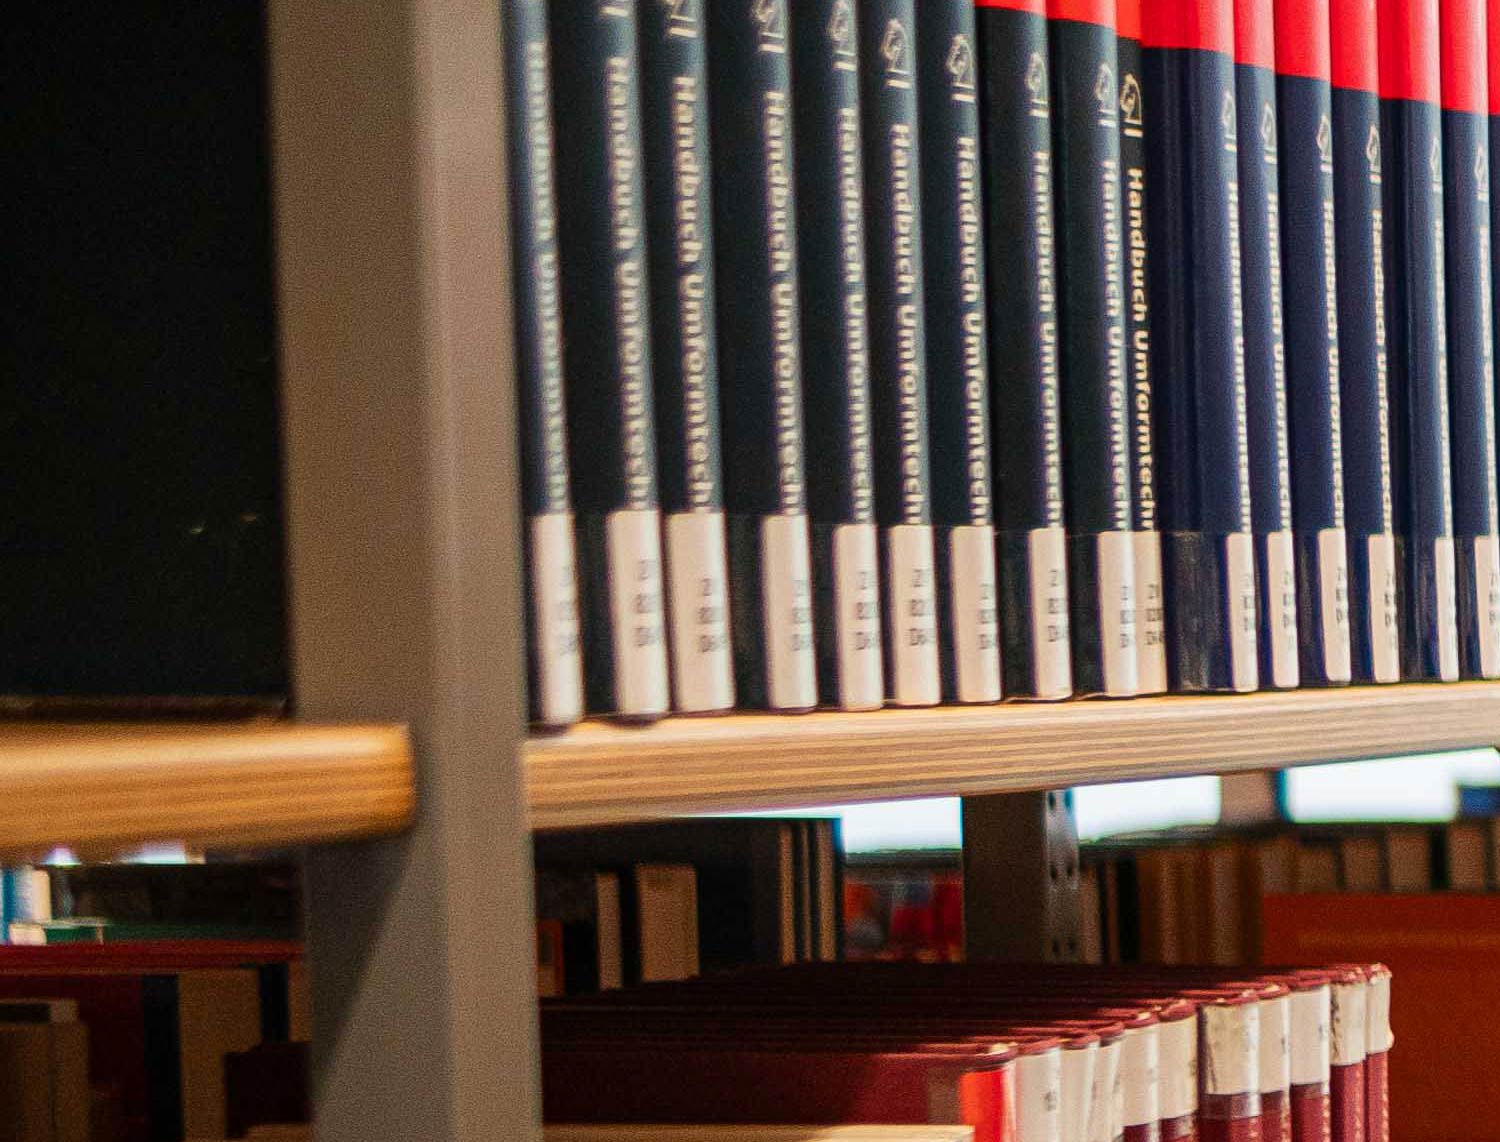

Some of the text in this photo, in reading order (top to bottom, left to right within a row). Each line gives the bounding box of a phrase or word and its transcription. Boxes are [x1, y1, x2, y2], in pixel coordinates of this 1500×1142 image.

[674, 76, 702, 263] Handbuch
[765, 90, 790, 273] Handbuch
[839, 107, 863, 283] Handbuch
[890, 122, 915, 294] Handbuch
[957, 137, 982, 302] Handbuch
[1034, 151, 1056, 312] Handbuch
[1101, 160, 1121, 315] Handbuch
[1127, 168, 1148, 322] Handbuch
[1323, 200, 1339, 338] Handbuch
[1372, 208, 1387, 344] Handbuch
